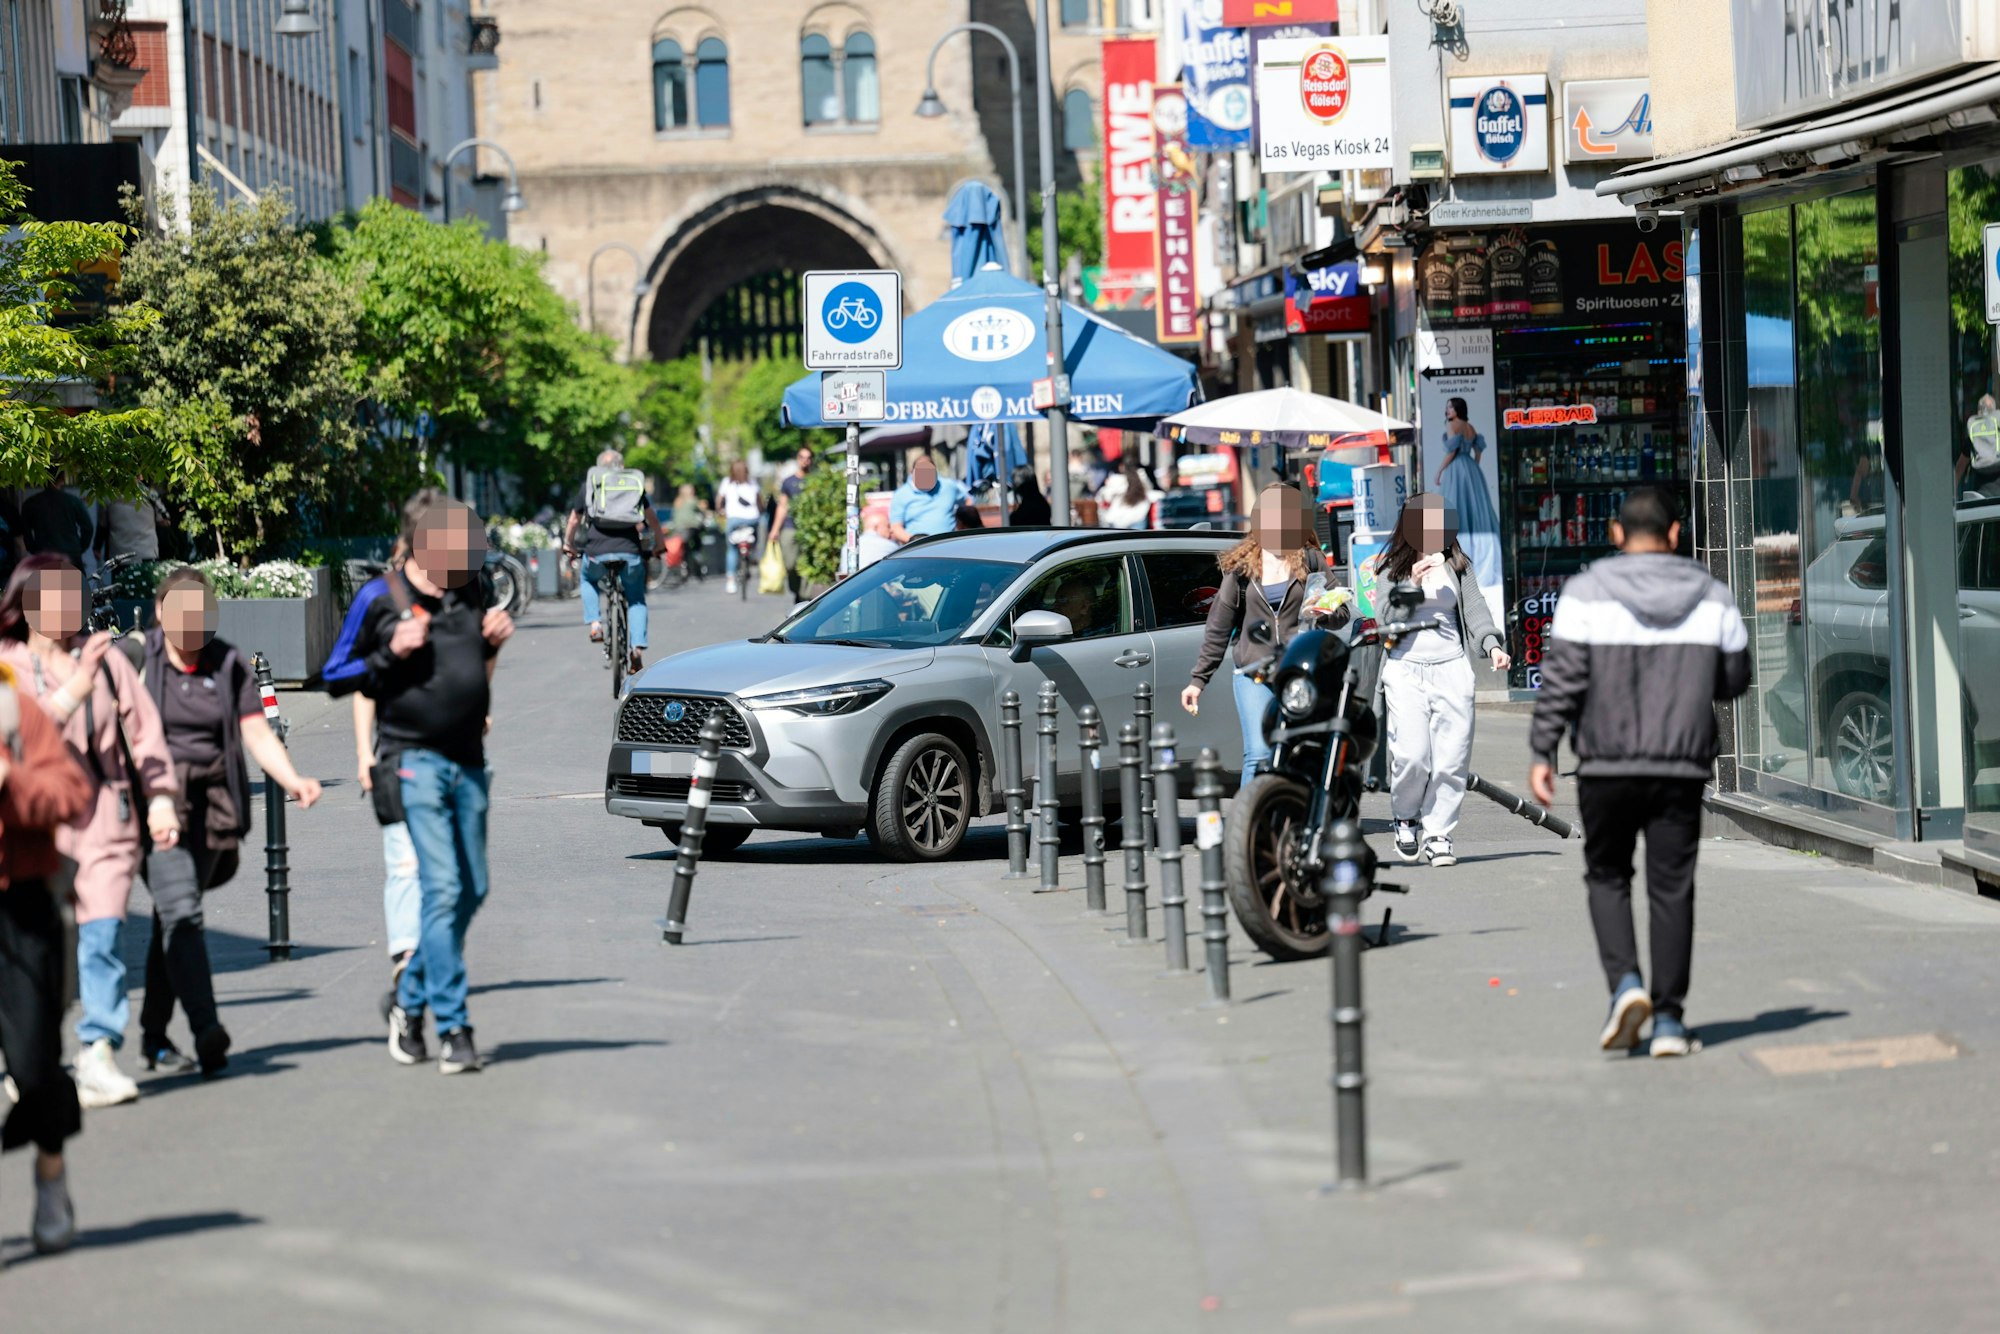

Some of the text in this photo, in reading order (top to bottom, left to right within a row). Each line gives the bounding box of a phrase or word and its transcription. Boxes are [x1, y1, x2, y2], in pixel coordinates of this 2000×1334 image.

[1303, 78, 1347, 93] Reissdorf
[1310, 93, 1342, 107] Kölsch
[1477, 114, 1522, 133] Gaffel
[1485, 132, 1514, 145] Kölsch
[1264, 137, 1390, 160] Las Vegas Kiosk 24
[1108, 80, 1156, 234] REWE
[1437, 204, 1530, 219] Unter Krahnenbäumen
[1598, 240, 1684, 285] LAS
[1306, 267, 1349, 295] sky
[1459, 307, 1482, 316] COLA
[1576, 296, 1659, 313] Spirituosen
[1304, 307, 1352, 324] sport
[1461, 335, 1491, 346] VERA
[812, 349, 894, 360] Fahrradstraße
[1461, 345, 1491, 355] BRIDE
[1449, 367, 1479, 375] METER
[885, 397, 969, 421] OFBRÄU
